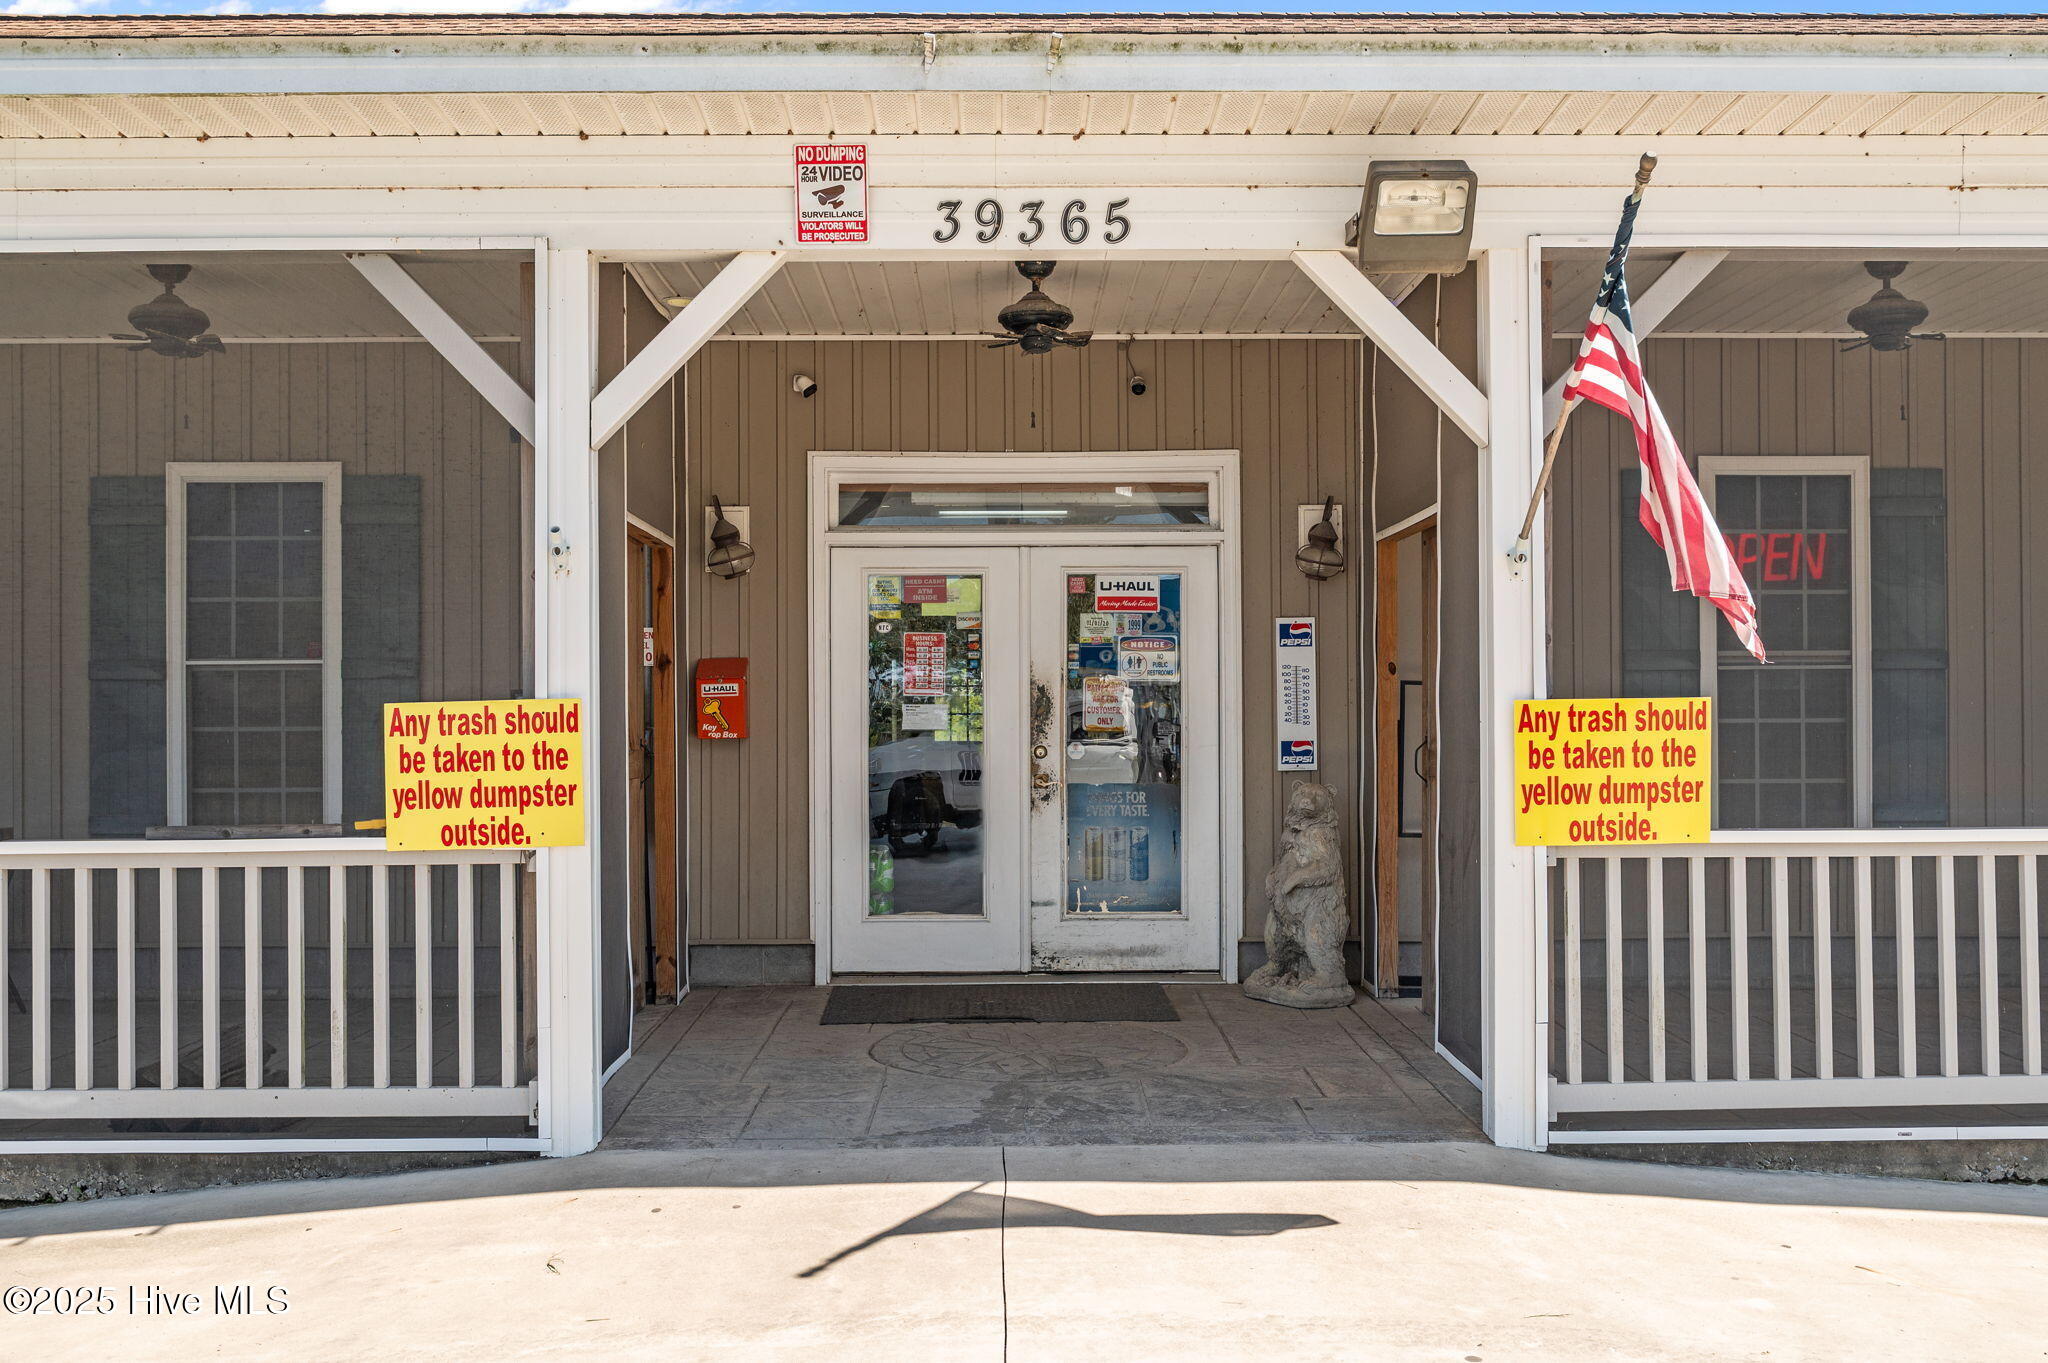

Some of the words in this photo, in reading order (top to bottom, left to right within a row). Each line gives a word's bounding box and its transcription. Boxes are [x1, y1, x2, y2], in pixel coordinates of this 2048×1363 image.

[798, 147, 814, 161] NO
[816, 146, 864, 161] DUMPING
[801, 166, 817, 175] 24
[819, 166, 863, 181] VIDEO
[801, 222, 844, 230] VIOLATORS
[932, 197, 1131, 244] 39365
[1100, 582, 1154, 591] U-HAUL
[1099, 600, 1120, 608] Moving
[389, 708, 430, 744] Any
[438, 706, 496, 736] trash
[505, 703, 578, 734] should
[1518, 704, 1560, 740] Any
[1568, 702, 1626, 732] trash
[1635, 701, 1707, 732] should
[400, 744, 426, 773] be
[433, 743, 495, 773] taken
[502, 742, 524, 771] to
[532, 741, 569, 770] the
[1528, 740, 1555, 769] be
[1563, 739, 1625, 769] taken
[1632, 739, 1653, 768] to
[1662, 738, 1696, 767] the
[392, 780, 463, 818] yellow
[470, 777, 577, 814] dumpster
[1126, 792, 1146, 803] FOR
[1521, 776, 1592, 814] yellow
[1600, 774, 1703, 811] dumpster
[1120, 805, 1150, 816] TASTE.
[441, 816, 531, 846] outside.
[1569, 812, 1657, 842] outside.
